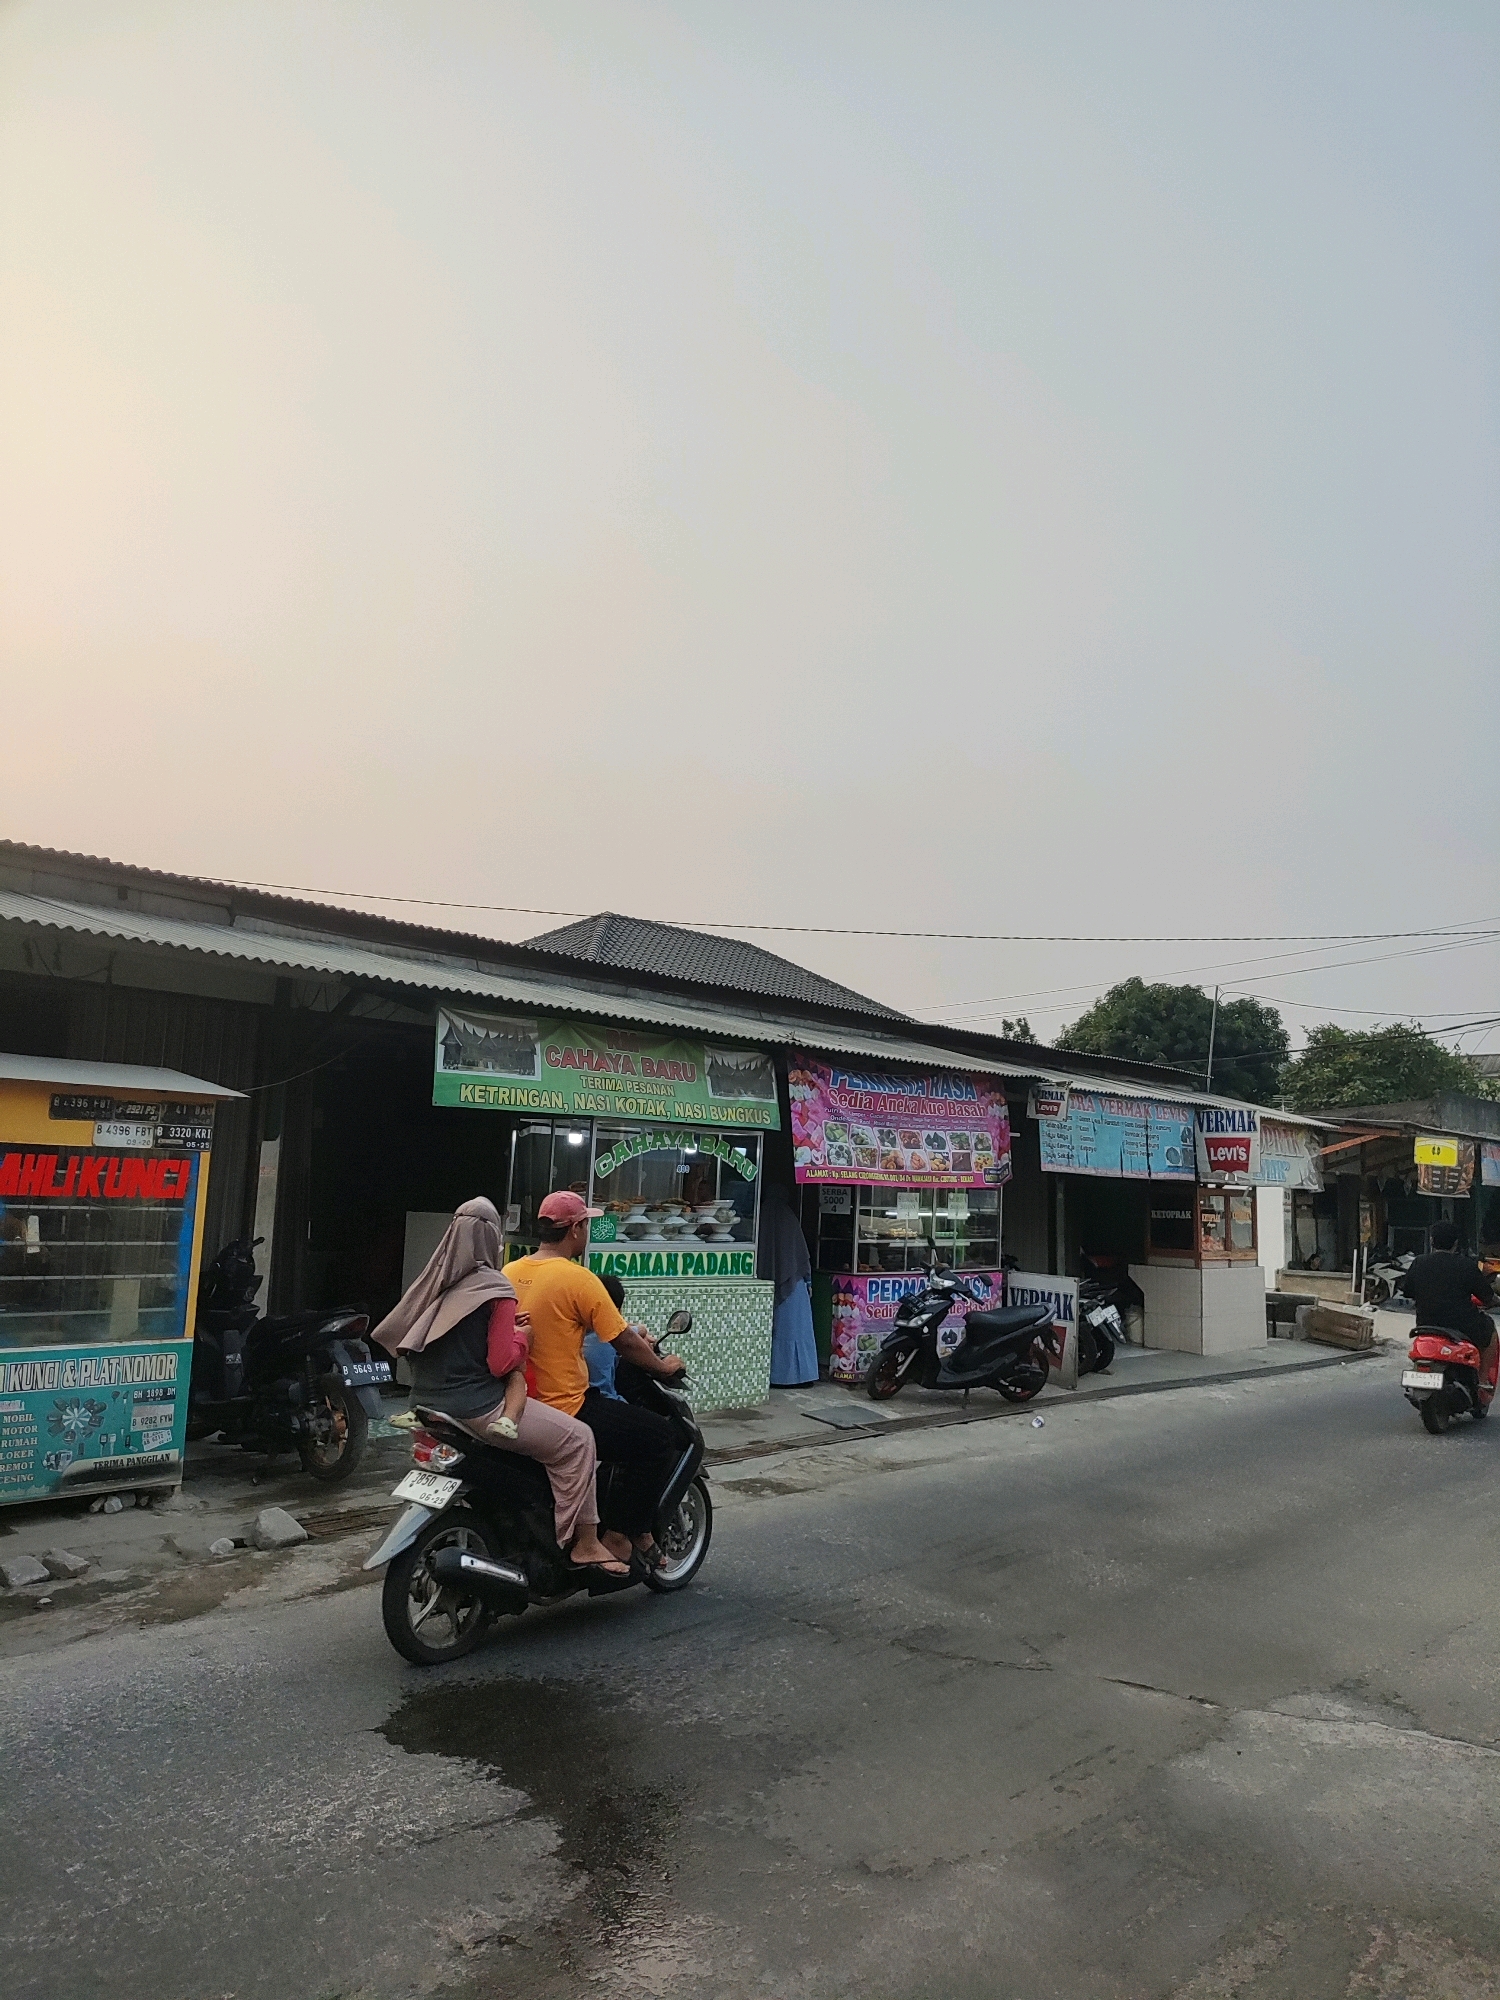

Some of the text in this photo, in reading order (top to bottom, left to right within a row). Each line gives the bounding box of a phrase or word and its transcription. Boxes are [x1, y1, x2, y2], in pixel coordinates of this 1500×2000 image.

[605, 1028, 640, 1053] RM
[543, 1044, 697, 1084] CAHAYA BARU
[580, 1075, 675, 1098] TERIMA PESANAN
[929, 1073, 978, 1102] RASA
[460, 1083, 771, 1125] KETRINGAN, NASI KOTAK, NASI BUNGKUS
[827, 1088, 988, 1117] Sedia Aneka Kue Basah
[1098, 1097, 1152, 1119] VERMAK
[1195, 1110, 1258, 1134] VERMAK
[96, 1125, 152, 1138] B 4396 FBT
[156, 1127, 212, 1139] B 3320 KRI
[595, 1130, 758, 1182] CAHAYA BARU
[0, 1153, 191, 1199] AHLI KUNCI
[822, 1188, 848, 1196] SERBA
[824, 1196, 845, 1205] 5000
[831, 1205, 837, 1213] 4
[1151, 1210, 1192, 1219] KETOPRAK
[588, 1252, 753, 1277] MASAKAN PADANG
[7, 1361, 62, 1392] KUNCI
[63, 1359, 78, 1388] &
[79, 1356, 121, 1387] PLAT
[121, 1353, 177, 1384] NOMOR
[342, 1365, 349, 1376] B
[353, 1364, 373, 1375] 5649
[3, 1413, 35, 1424] MOBIL
[2, 1425, 38, 1436] MOTOR
[1, 1437, 38, 1448] RUMAH
[0, 1449, 34, 1460] LOKER
[93, 1453, 171, 1470] TERIMA PANGGILAN
[0, 1461, 35, 1473] REMOT
[411, 1473, 438, 1487] 3850
